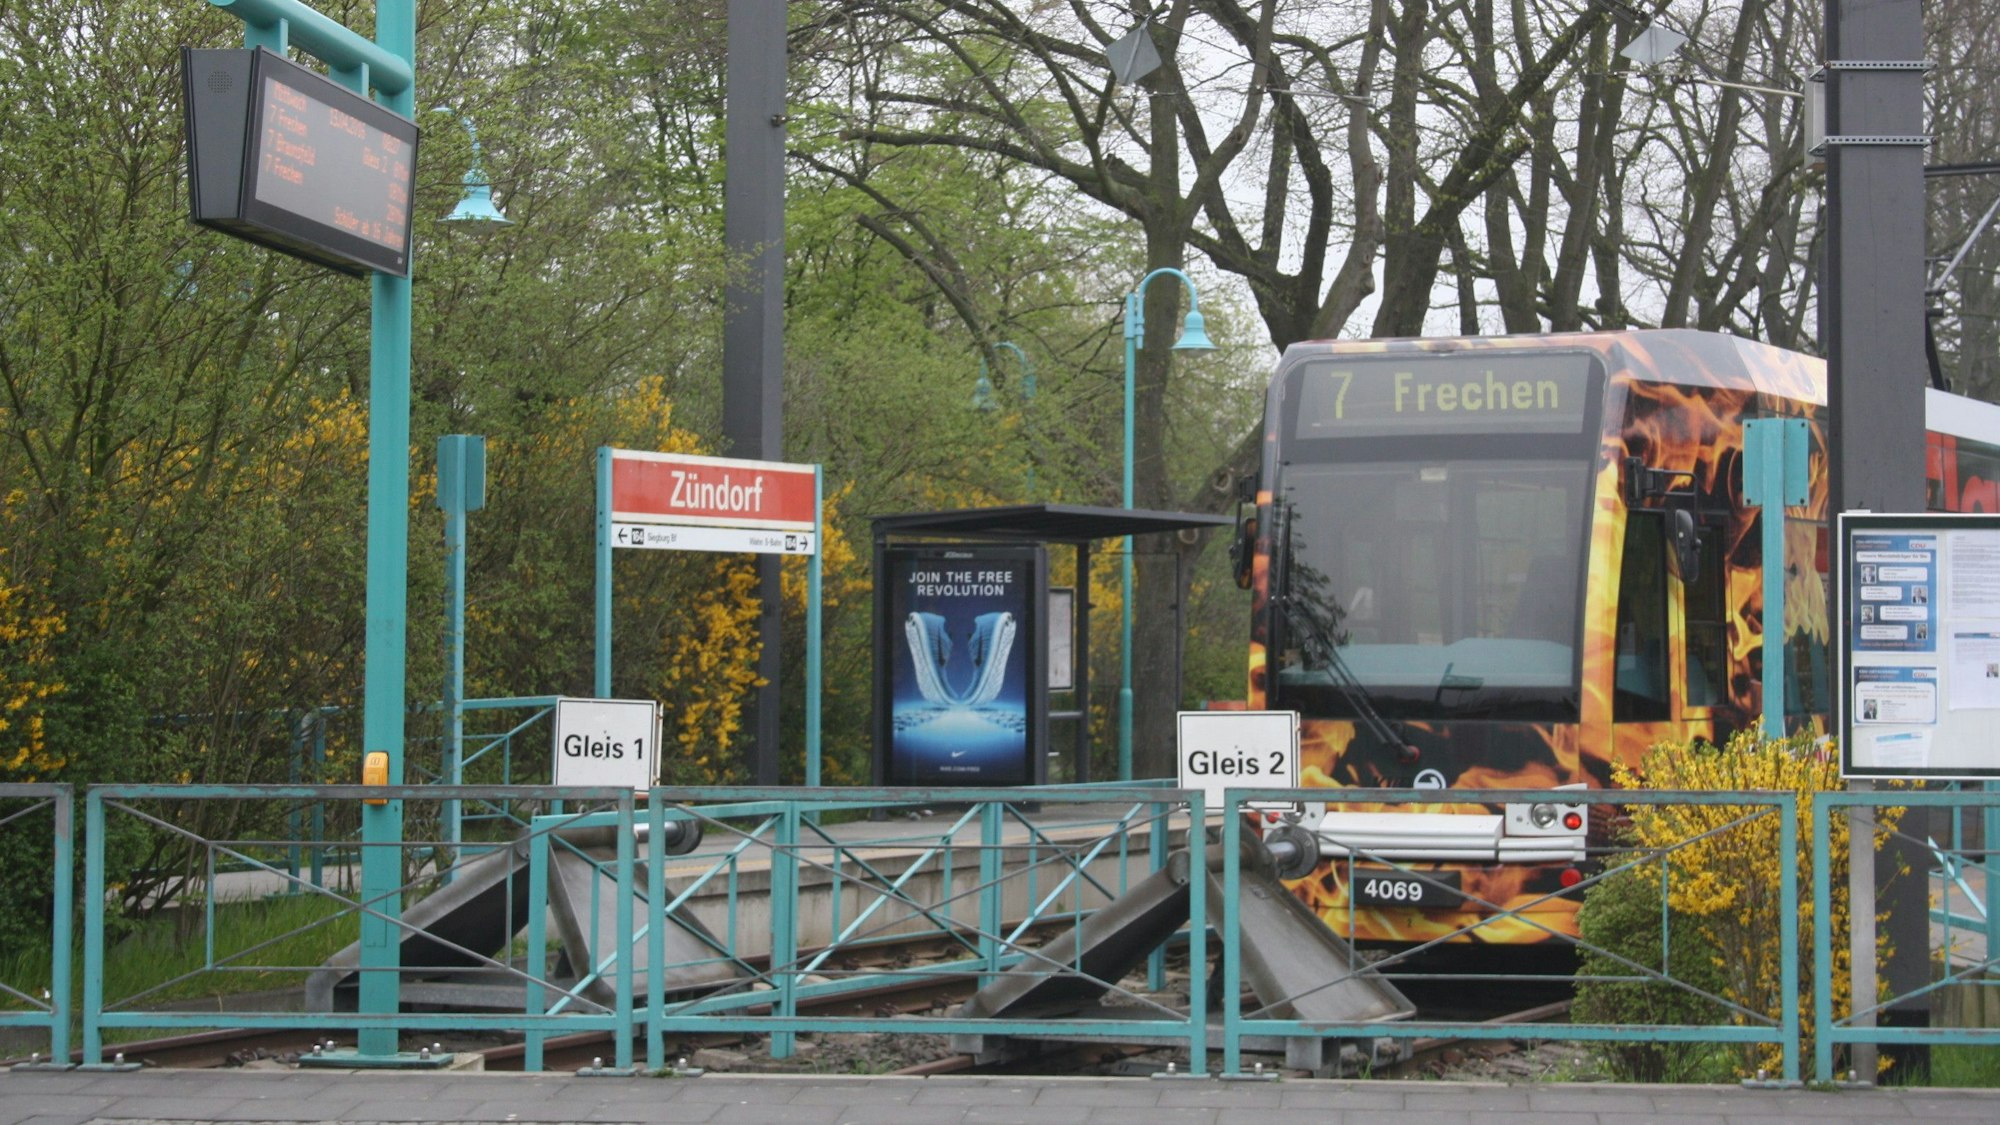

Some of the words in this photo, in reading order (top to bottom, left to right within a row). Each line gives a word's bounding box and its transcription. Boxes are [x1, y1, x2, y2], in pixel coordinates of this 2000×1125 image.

[1330, 371, 1353, 419] 7
[1394, 370, 1559, 413] Frechen
[670, 470, 763, 512] Zündorf
[647, 532, 670, 544] Siegburg
[908, 571, 941, 583] JOIN
[946, 571, 972, 583] THE
[978, 571, 1013, 583] FREE
[917, 584, 1005, 596] REVOLUTION
[564, 734, 624, 760] Gleis
[634, 738, 643, 760] 1
[1188, 750, 1260, 776] Gleis
[1269, 751, 1285, 775] 2
[1364, 878, 1423, 901] 4069
